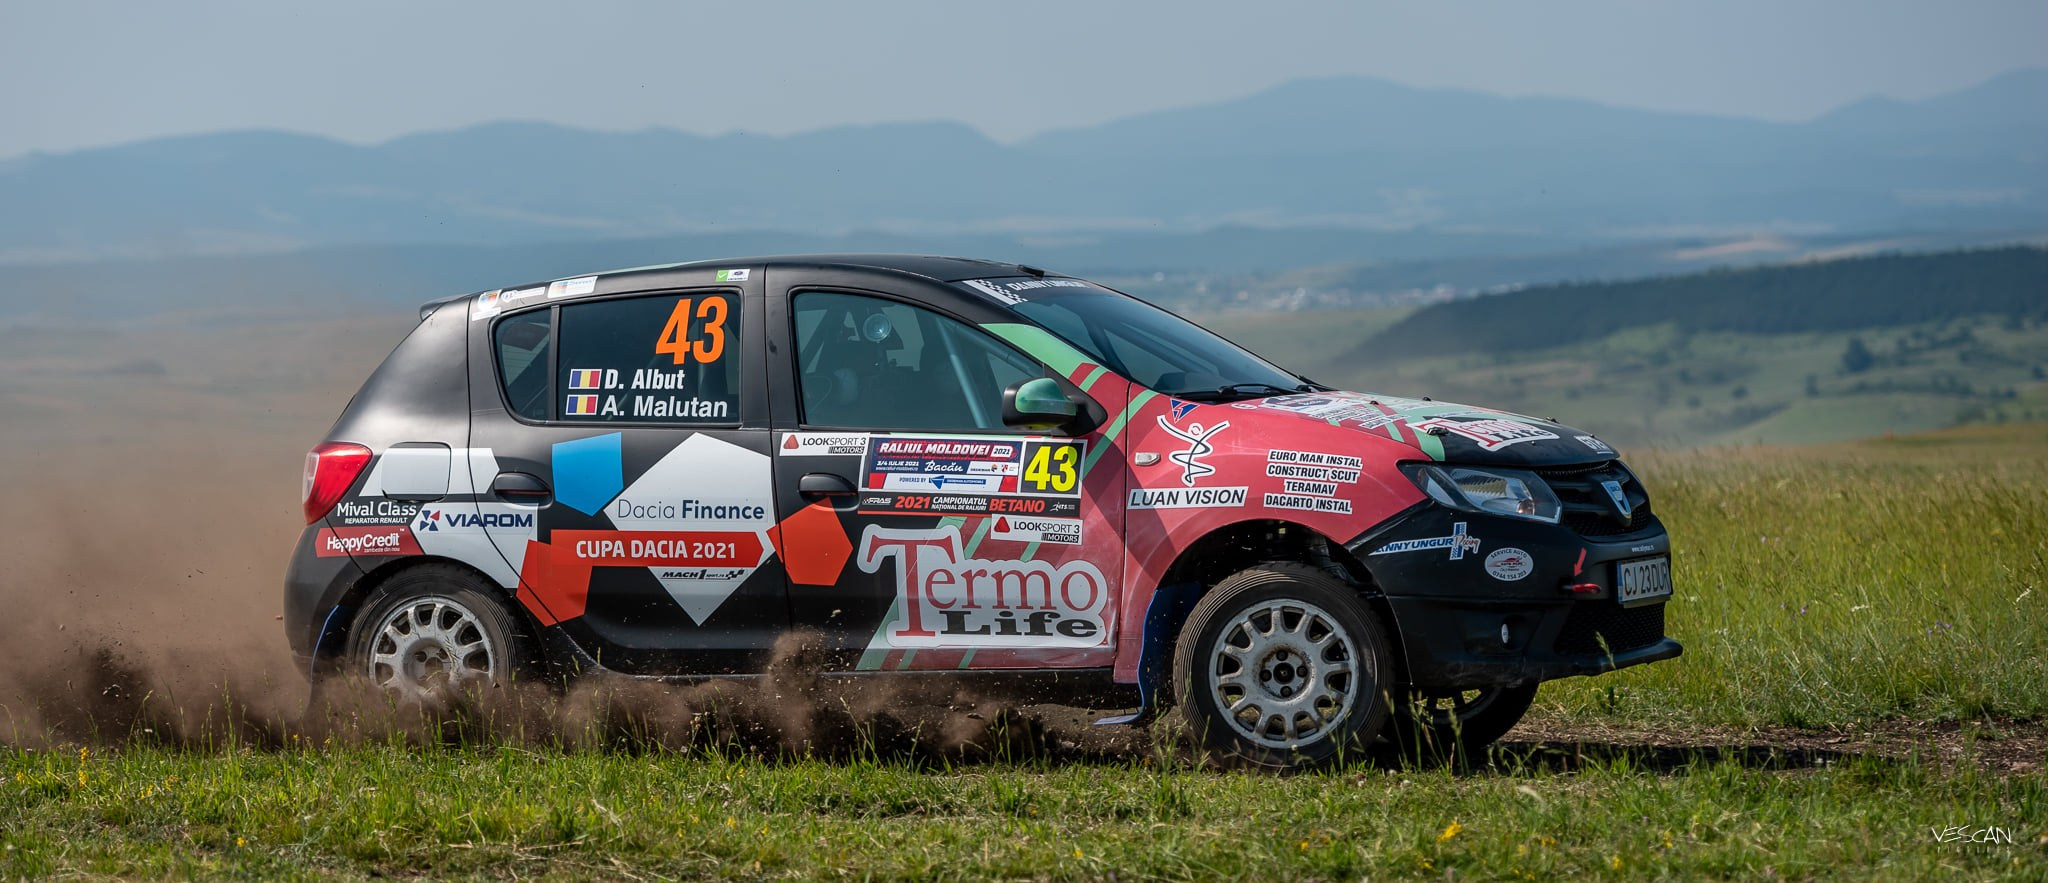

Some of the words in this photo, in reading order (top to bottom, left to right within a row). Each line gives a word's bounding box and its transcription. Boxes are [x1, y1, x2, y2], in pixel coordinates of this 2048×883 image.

[656, 296, 728, 365] 43
[604, 369, 624, 389] D.
[630, 369, 685, 389] Albut
[601, 395, 624, 416] A.
[633, 395, 728, 417] Malutan
[860, 438, 866, 446] 3
[880, 443, 923, 454] RALIUL
[925, 443, 990, 456] MOLDOVEI
[925, 460, 963, 472] Bacău
[1270, 451, 1297, 461] EURO
[1300, 453, 1323, 463] MAN
[1326, 456, 1361, 467] INSTAL
[1025, 445, 1078, 492] 43
[1268, 465, 1328, 478] CONSTRUCT
[1331, 470, 1358, 481] SCUT
[1286, 481, 1335, 494] TERAMAV
[895, 496, 931, 509] 2021
[932, 496, 988, 506] CAMPIONATUL
[989, 499, 1046, 513] BETANO
[1130, 491, 1179, 506] LUAN
[1185, 489, 1245, 505] VISION
[1265, 495, 1313, 508] DACARTO
[1316, 499, 1351, 512] INSTAL
[337, 502, 375, 517] Mival
[377, 502, 417, 516] Class
[617, 499, 675, 519] Dacia
[682, 500, 765, 519] Finance
[445, 514, 533, 528] VIAROM
[1014, 521, 1072, 533] LOOKSPORT
[1074, 525, 1080, 533] 3
[327, 533, 400, 552] HappyCredit
[1047, 533, 1078, 543] MOTORS
[576, 540, 625, 558] CUPA
[631, 540, 688, 558] DACIA
[693, 543, 735, 558] 2021
[1491, 549, 1512, 558] SERVICE
[1513, 549, 1527, 558] AUTO
[866, 535, 1098, 637] Termo
[1624, 568, 1637, 596] CJ
[1640, 565, 1651, 594] 23
[1651, 562, 1669, 592] DUR
[939, 611, 1098, 637] Life
